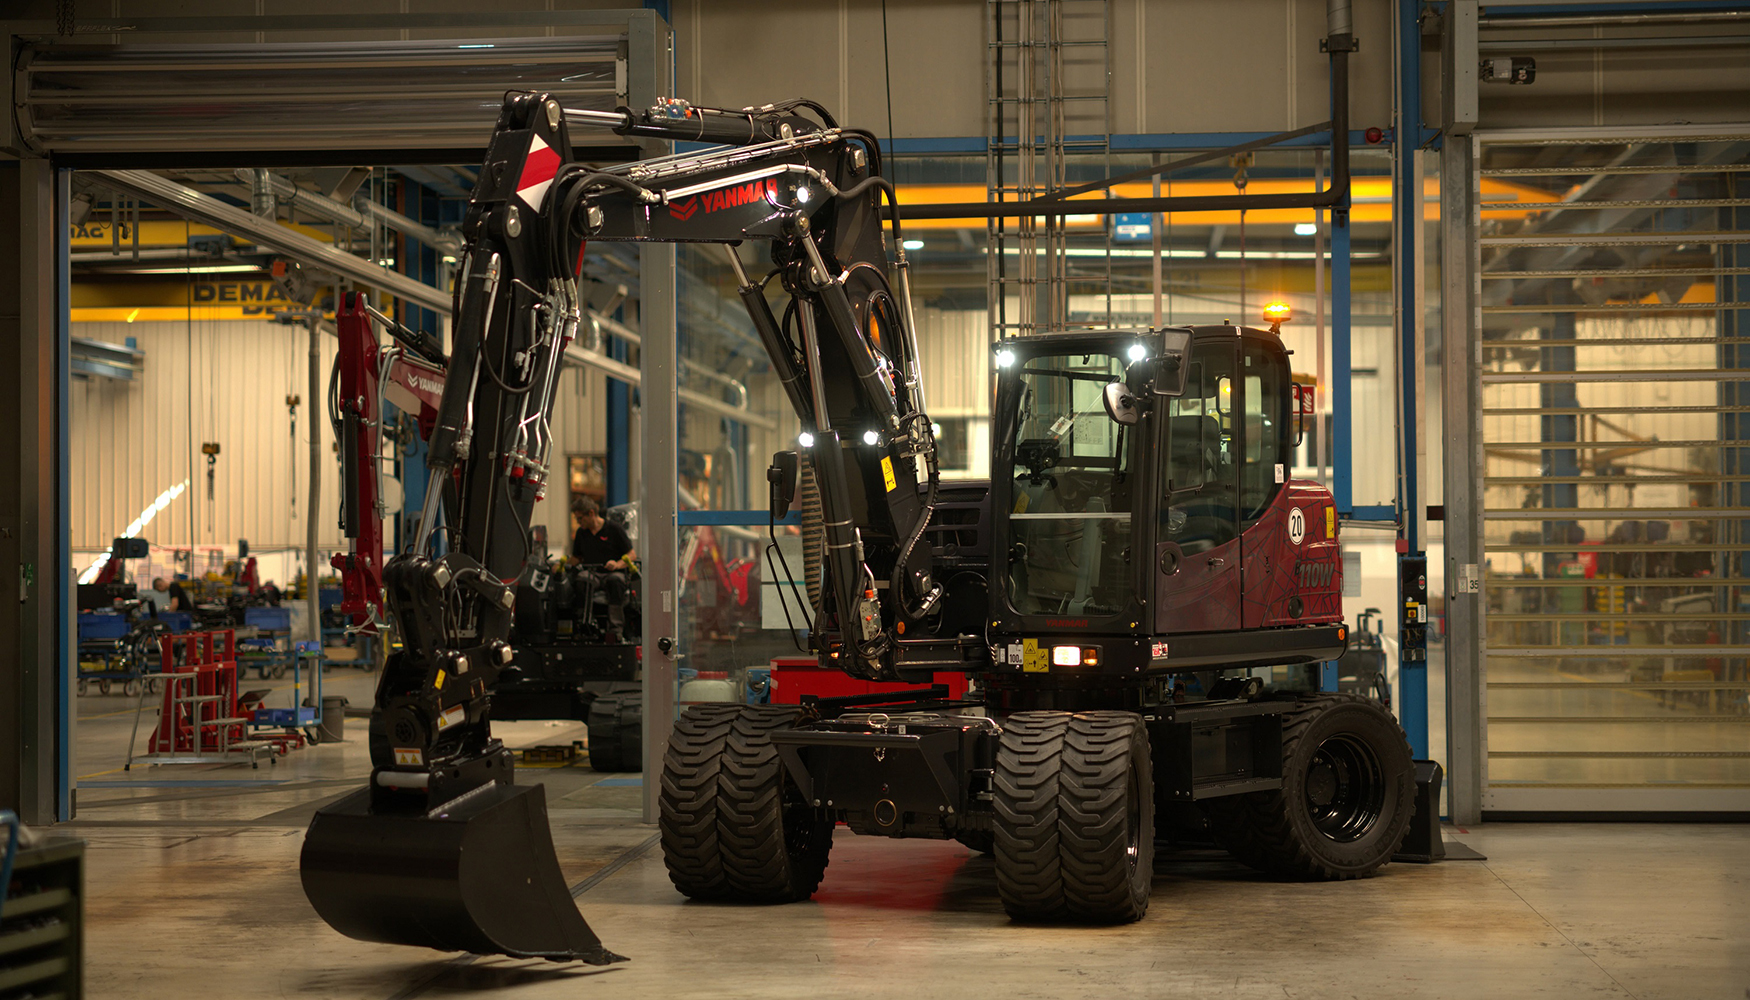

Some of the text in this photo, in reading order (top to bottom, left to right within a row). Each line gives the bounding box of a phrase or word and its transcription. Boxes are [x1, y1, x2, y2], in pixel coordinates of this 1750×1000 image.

[194, 284, 287, 302] DEMA
[1292, 515, 1302, 537] 20
[1469, 580, 1479, 590] 35
[1045, 619, 1089, 628] YANMAR
